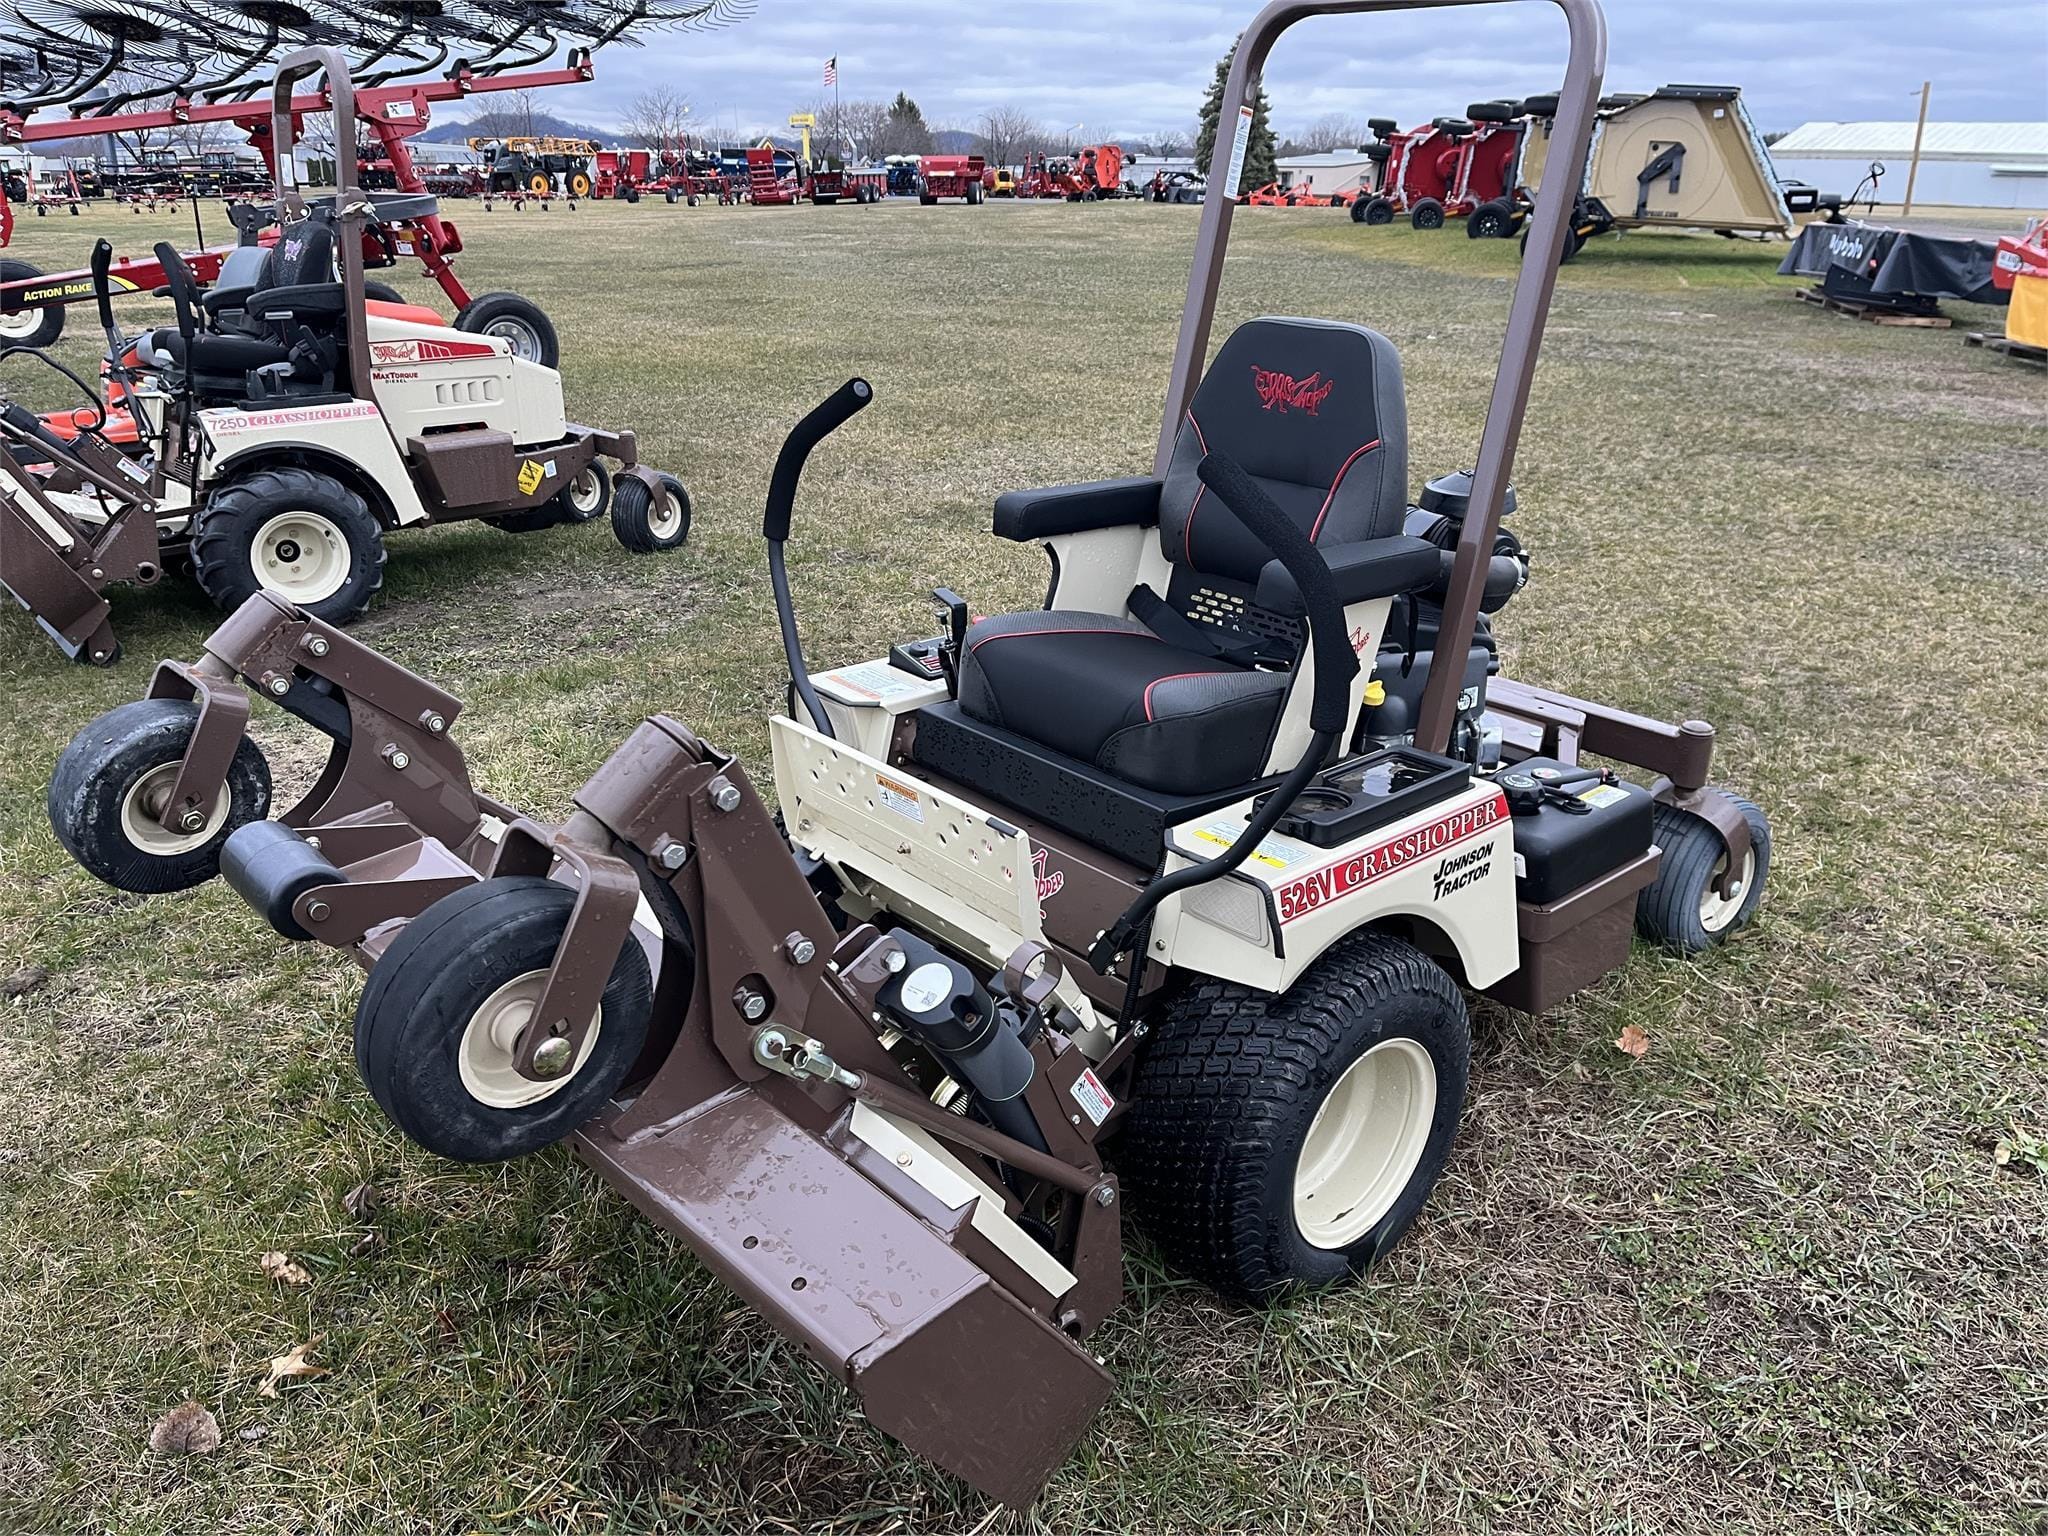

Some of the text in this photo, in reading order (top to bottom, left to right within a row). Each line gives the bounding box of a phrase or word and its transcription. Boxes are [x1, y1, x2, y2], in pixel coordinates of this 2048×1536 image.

[23, 282, 92, 302] ACTION RAKE
[208, 406, 369, 431] 725D GRASSHOPPER
[1279, 799, 1499, 919] 526V GRASSHOPPER
[1433, 841, 1494, 881] JOHNSON
[1433, 862, 1491, 902] TRACTOR
